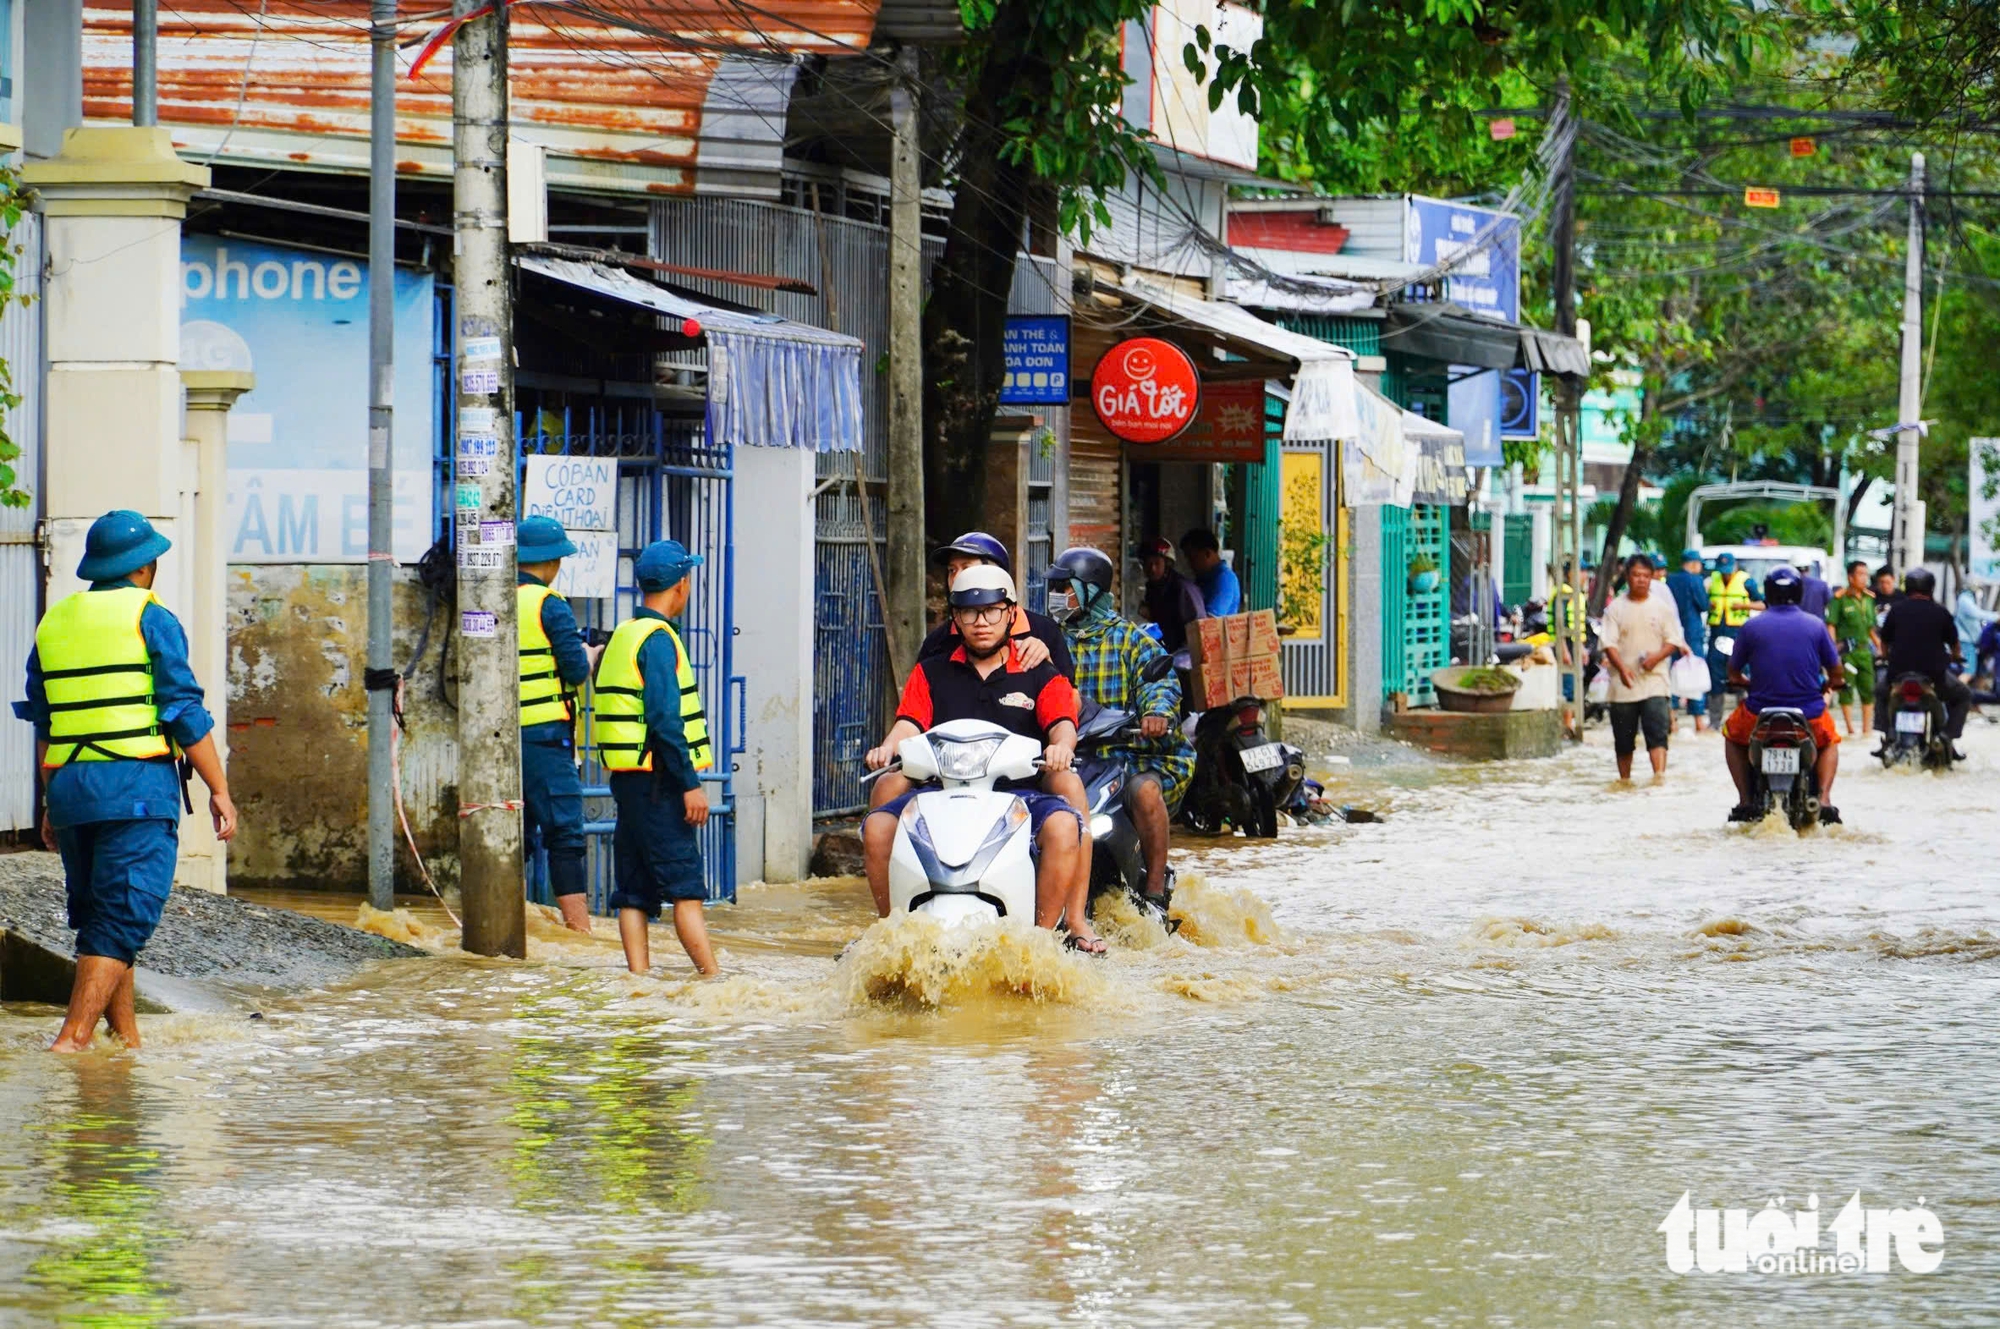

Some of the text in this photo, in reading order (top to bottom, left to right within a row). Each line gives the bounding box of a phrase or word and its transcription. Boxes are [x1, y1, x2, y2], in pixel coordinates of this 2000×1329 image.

[180, 248, 361, 309] phone
[226, 475, 319, 555] ÂM
[554, 488, 596, 507] CARD
